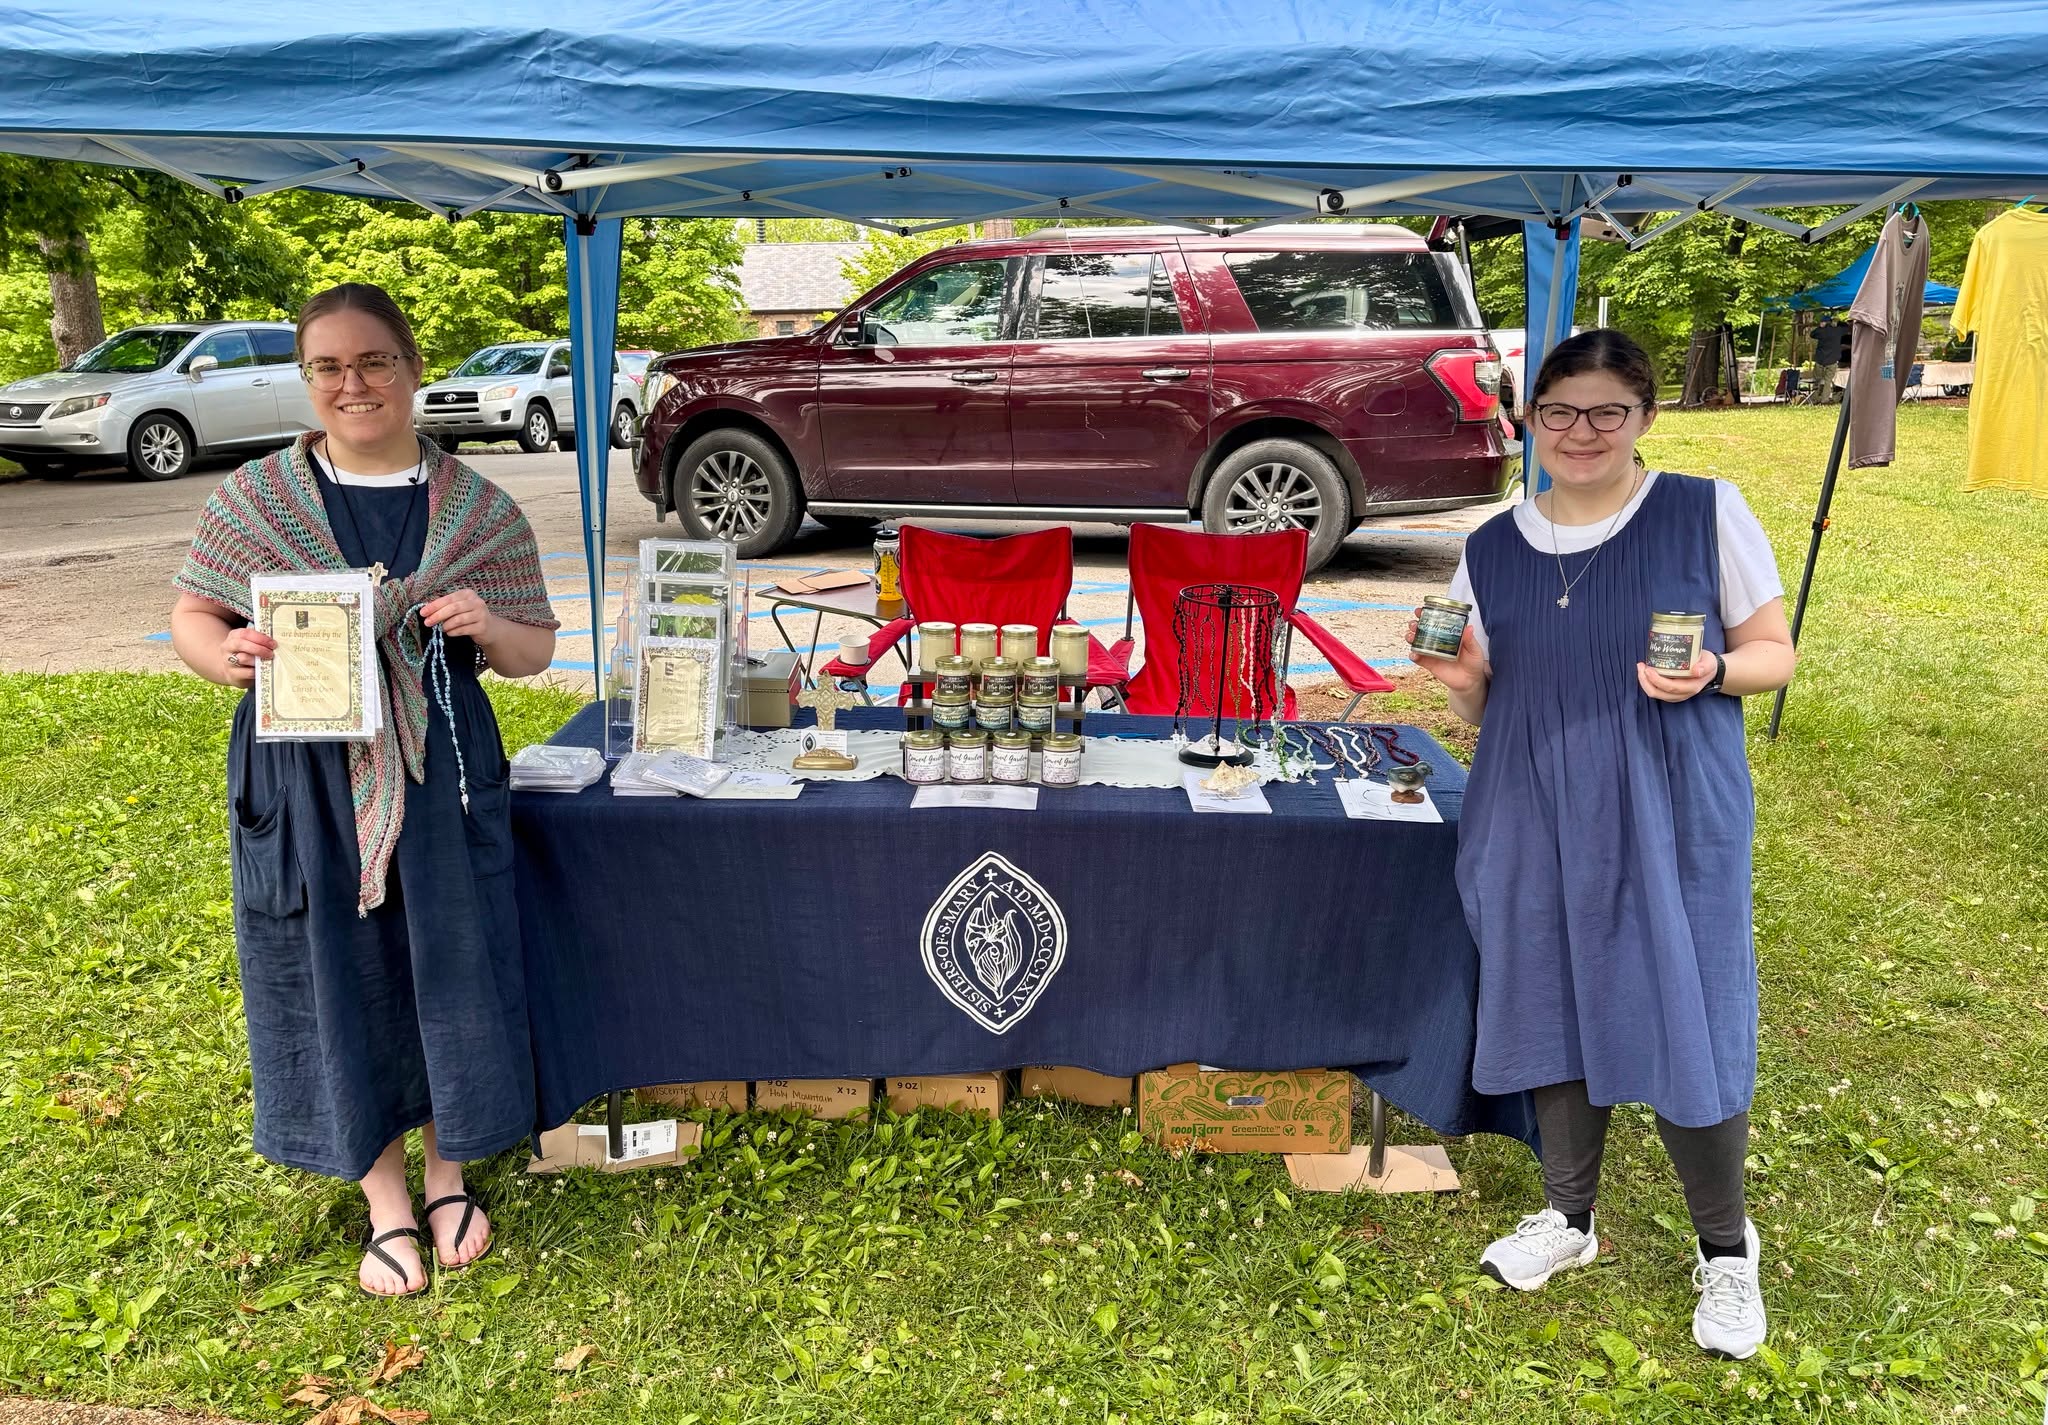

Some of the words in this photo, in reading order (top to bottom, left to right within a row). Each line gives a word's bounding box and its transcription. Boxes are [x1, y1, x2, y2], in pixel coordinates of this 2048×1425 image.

[775, 1080, 789, 1088] OZ
[897, 1081, 903, 1089] 9
[905, 1082, 918, 1090] OZ
[837, 1086, 843, 1094] X
[846, 1088, 857, 1096] 12
[966, 1085, 973, 1093] X
[975, 1086, 986, 1094] 12
[769, 1088, 788, 1099] Holy
[792, 1090, 833, 1103] Mountain
[1170, 1126, 1192, 1134] FOOD
[1206, 1126, 1224, 1134] CITY
